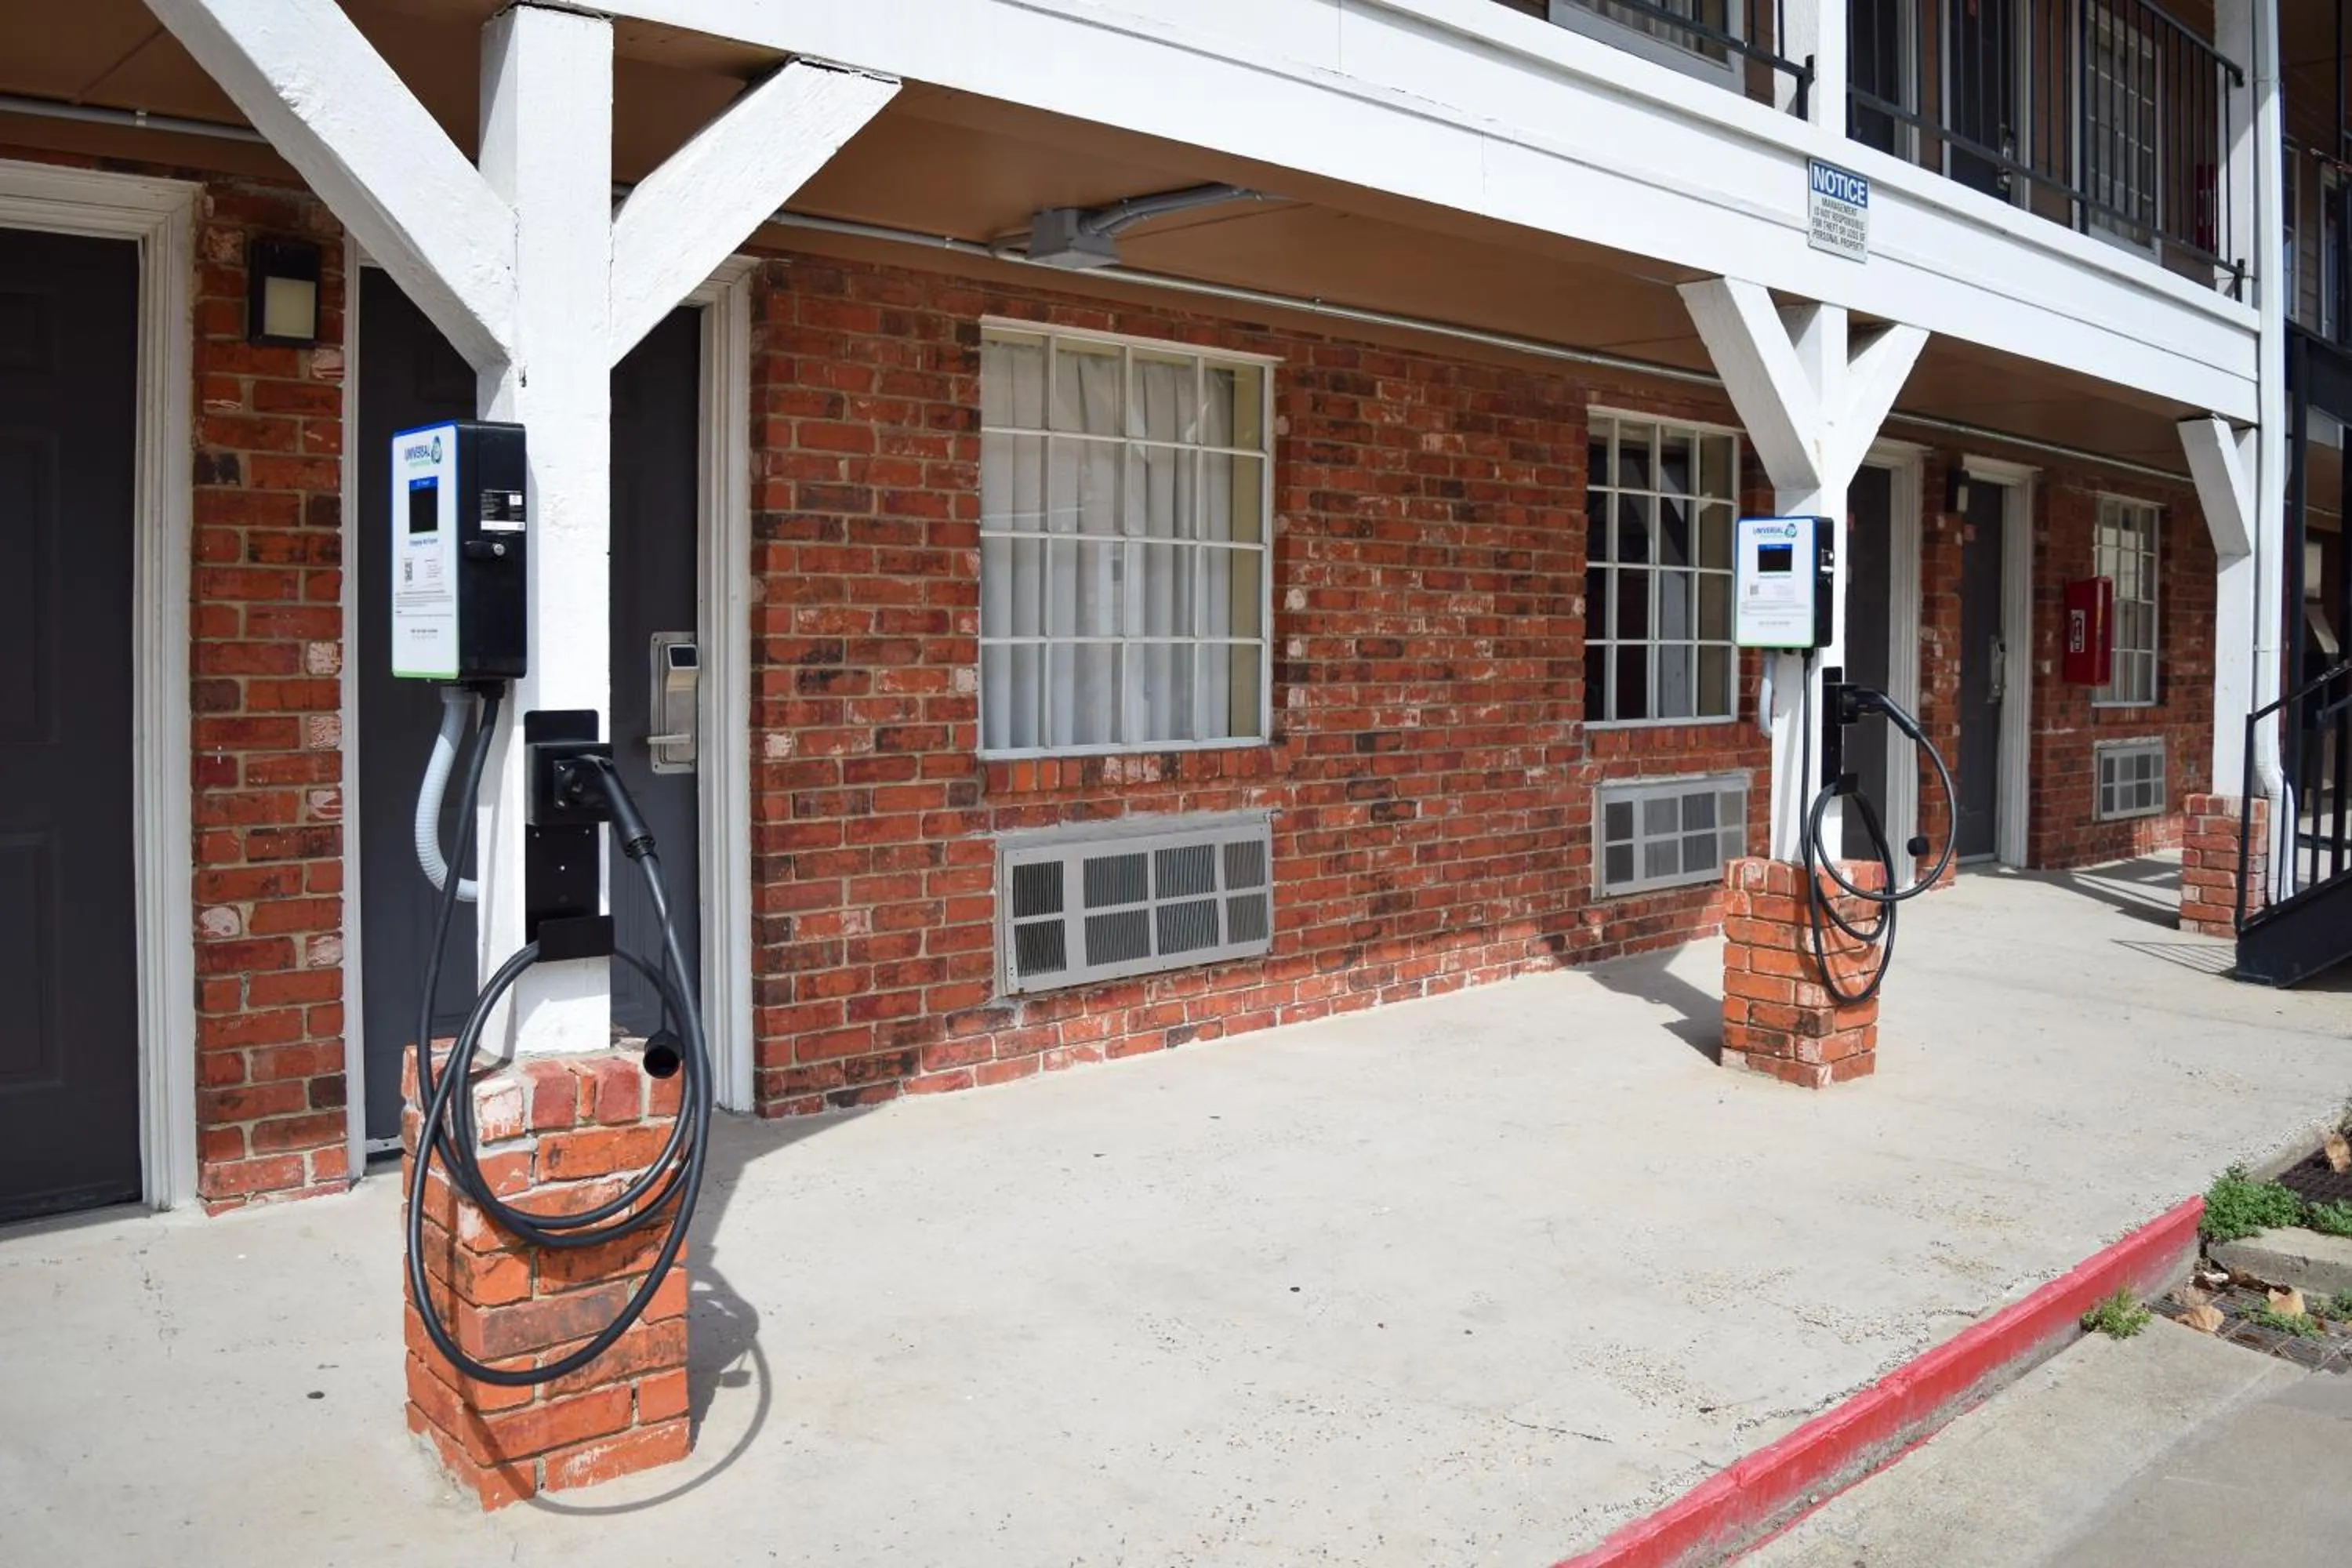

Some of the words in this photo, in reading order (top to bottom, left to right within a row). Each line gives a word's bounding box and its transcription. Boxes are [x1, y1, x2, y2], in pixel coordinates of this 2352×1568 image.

[1813, 166, 1866, 205] NOTICE
[1821, 197, 1857, 216] MANAGEMENT
[1823, 220, 1838, 233] THEFT
[1812, 228, 1839, 245] PERSONAL
[1840, 236, 1865, 252] PROPERTY
[405, 445, 430, 461] UNIVERSAL
[1752, 526, 1784, 535] UNIVERSAL
